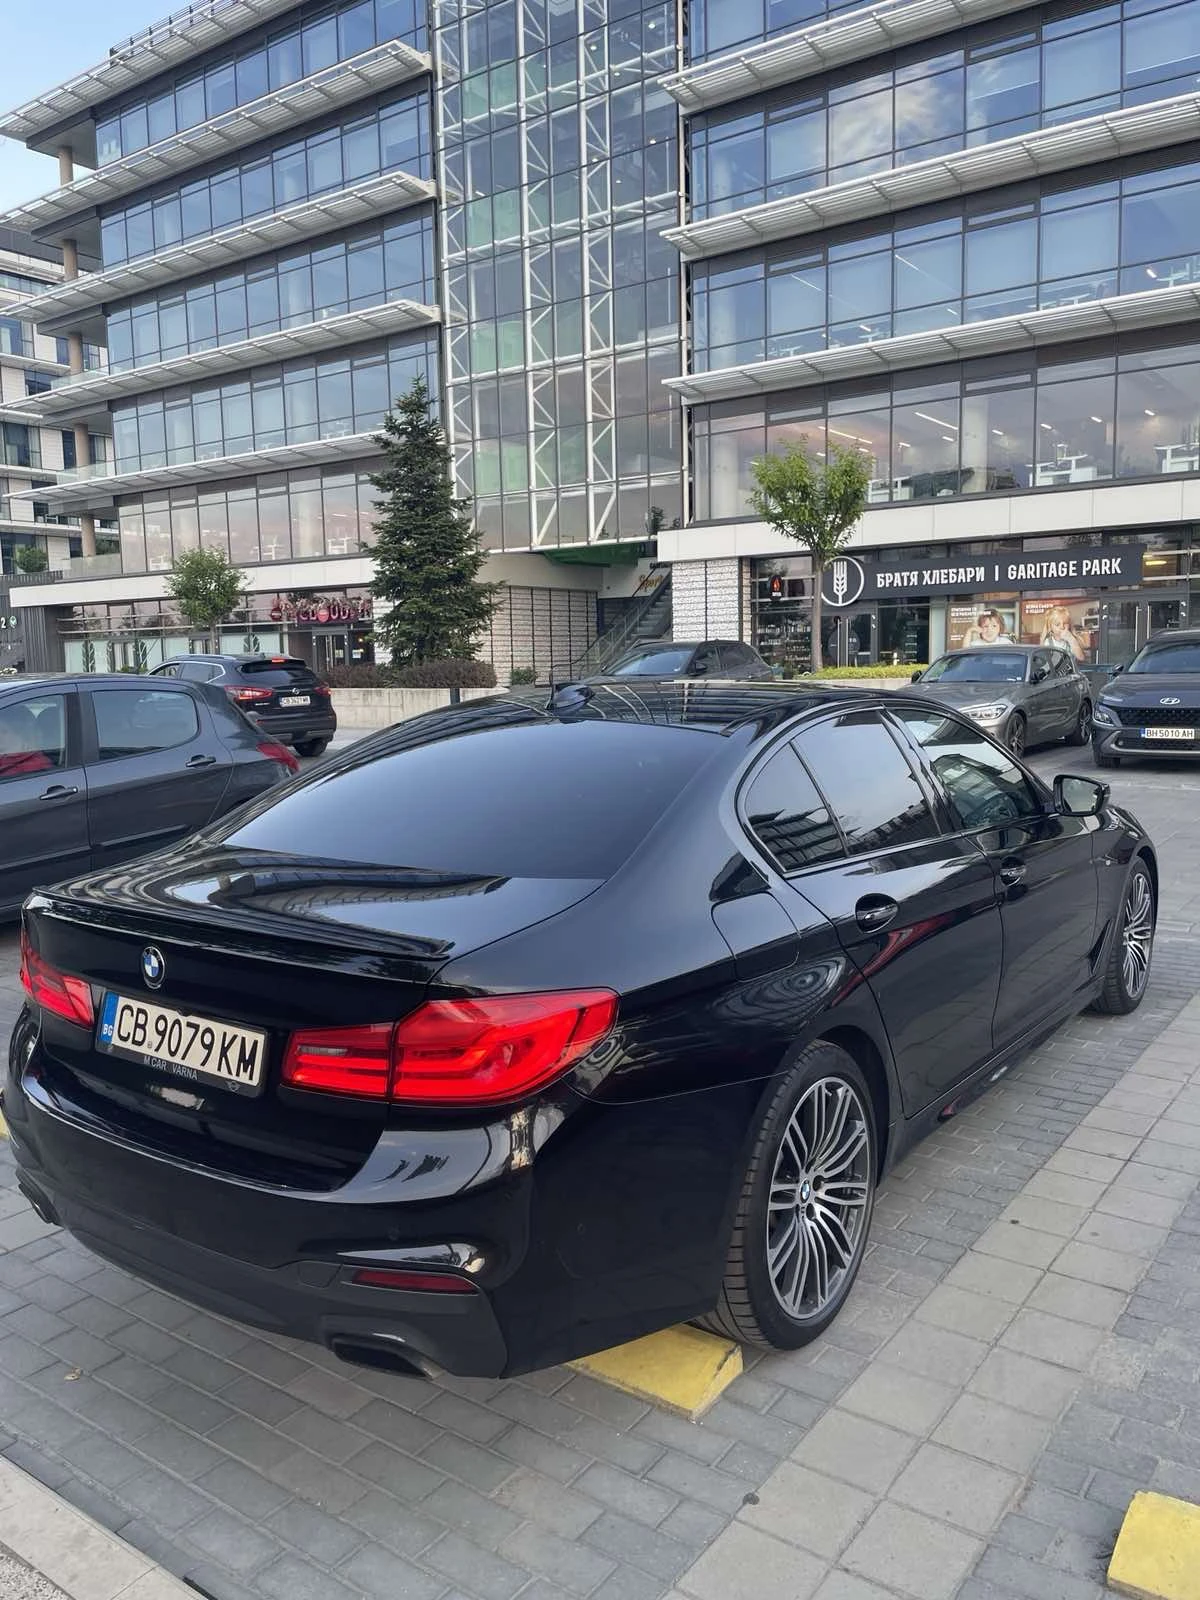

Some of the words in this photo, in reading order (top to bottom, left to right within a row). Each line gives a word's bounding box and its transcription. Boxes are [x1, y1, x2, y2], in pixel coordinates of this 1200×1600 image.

[876, 571, 919, 588] БРАТЯ
[922, 566, 985, 585] ХЛЕБАРИ
[1007, 560, 1077, 580] GARITAGE
[1082, 557, 1122, 576] PARK
[102, 1023, 114, 1037] BG
[154, 1014, 215, 1067] 9079
[217, 1031, 259, 1081] KM
[172, 1063, 198, 1081] VARNA
